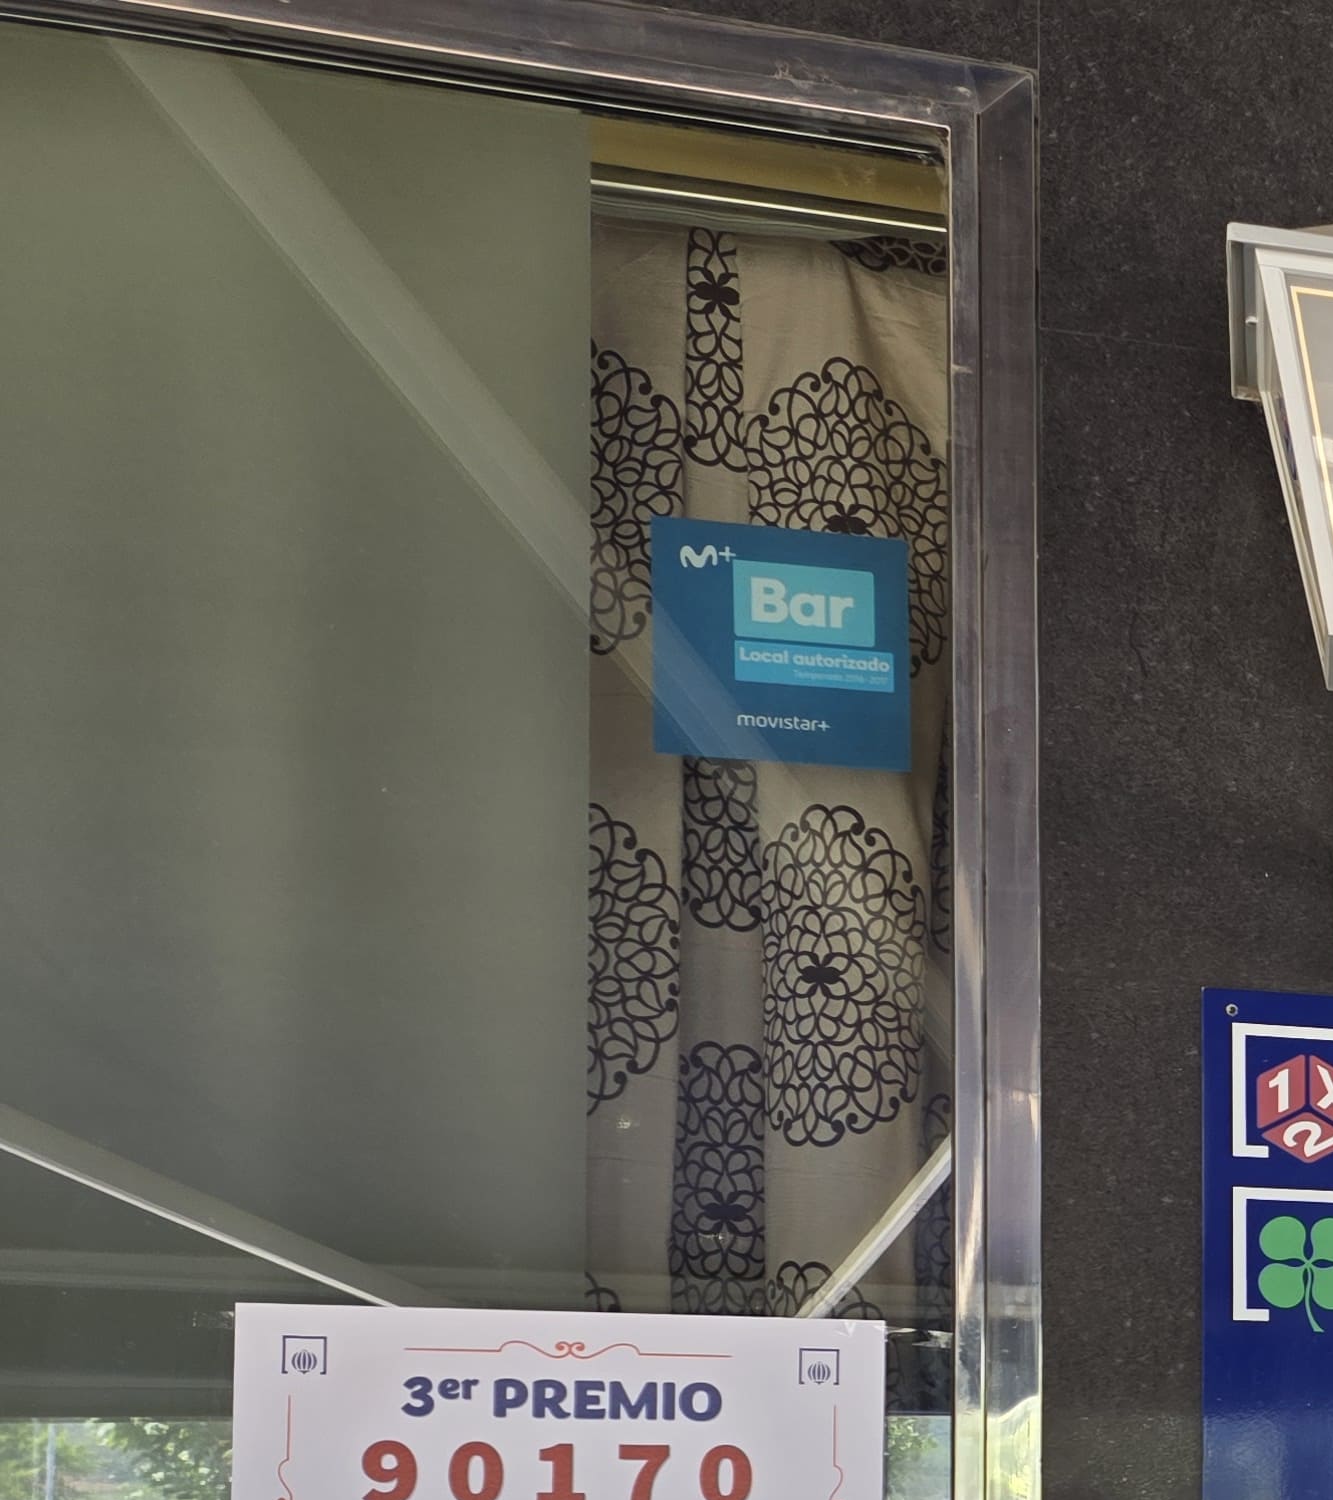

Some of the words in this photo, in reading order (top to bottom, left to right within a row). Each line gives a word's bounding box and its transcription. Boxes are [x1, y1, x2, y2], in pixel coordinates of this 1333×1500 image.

[751, 576, 854, 628] Bar
[740, 646, 788, 665] Local
[792, 651, 890, 673] autorizado
[401, 1375, 479, 1418] 3er
[492, 1378, 723, 1422] PREMIO
